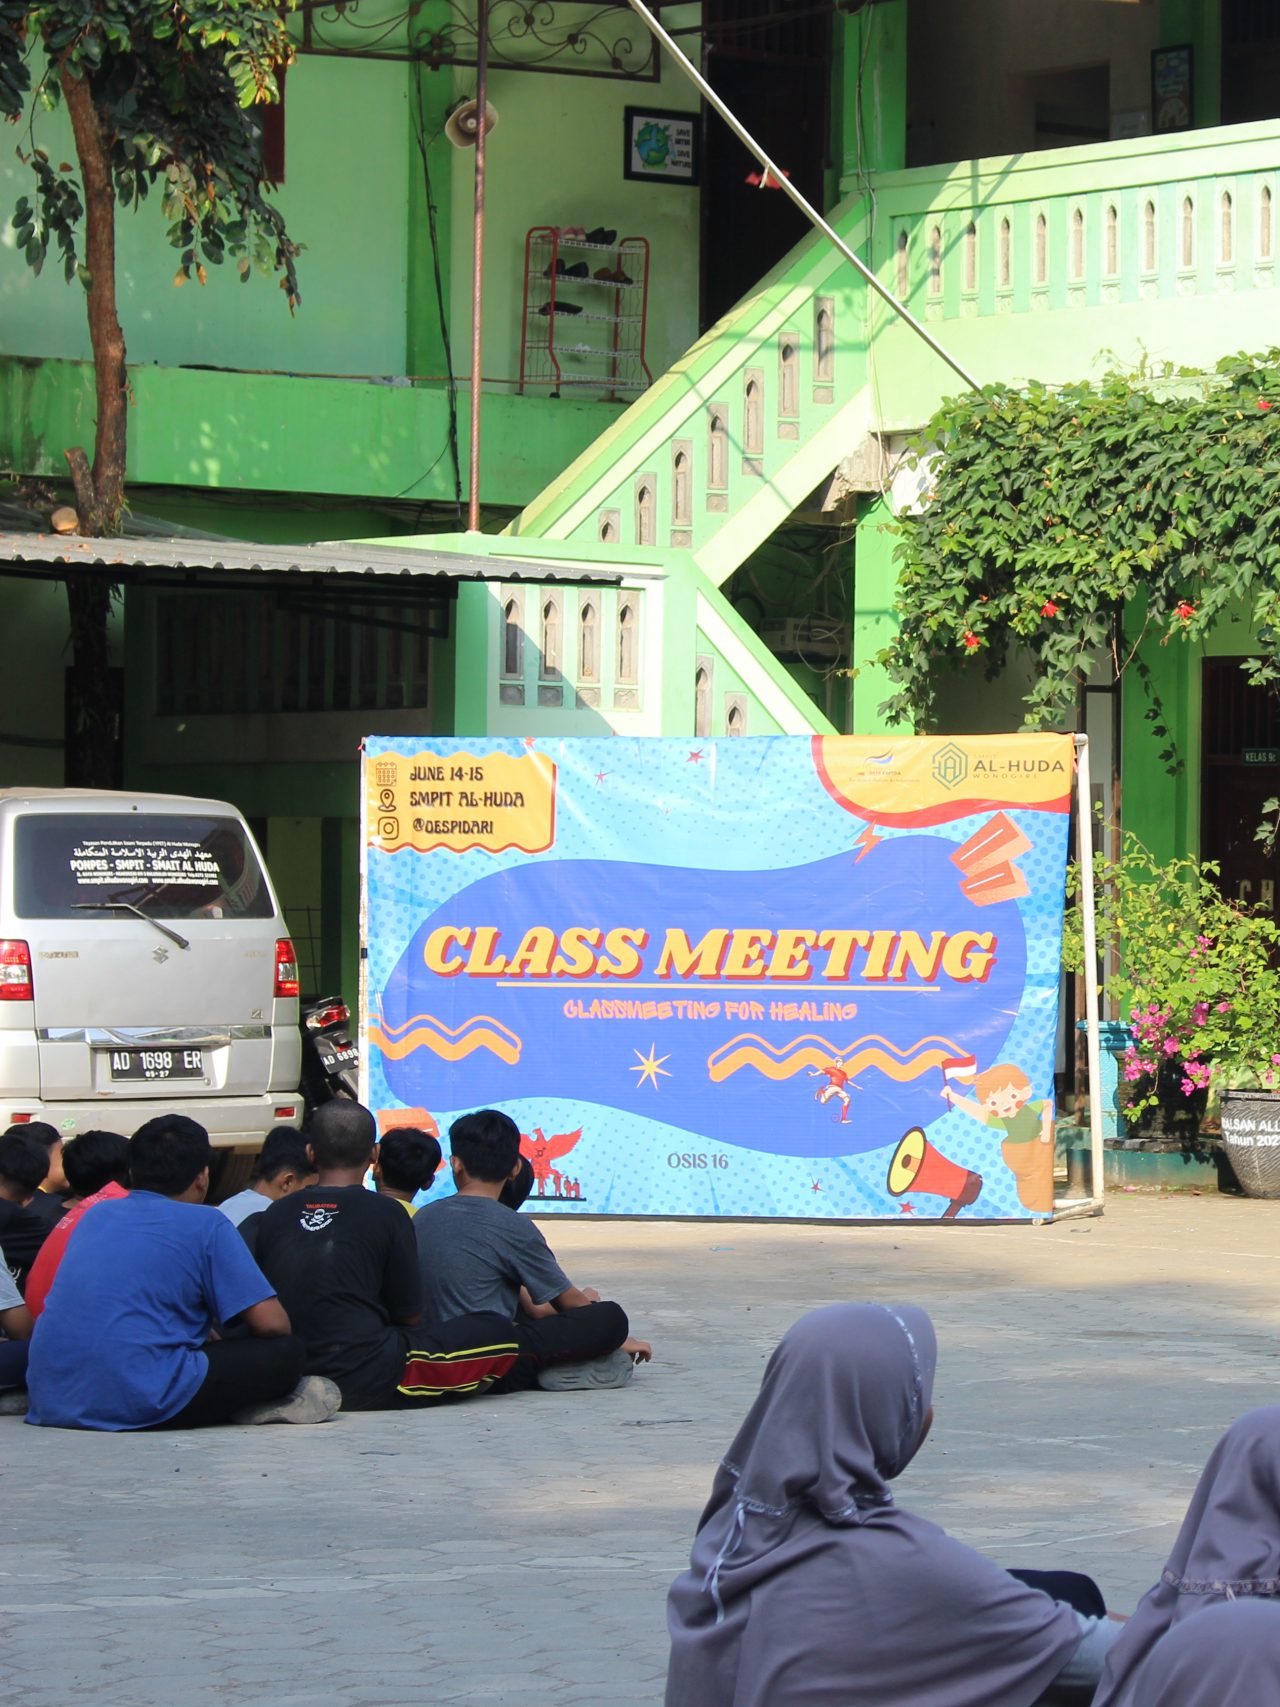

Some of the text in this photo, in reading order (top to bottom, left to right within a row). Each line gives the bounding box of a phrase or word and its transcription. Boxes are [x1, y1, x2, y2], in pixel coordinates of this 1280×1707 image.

[1245, 752, 1265, 762] KELAS
[410, 766, 444, 782] JUNE
[973, 760, 1065, 773] AL-HUDA
[409, 791, 525, 808] SMPIT AL-HUDA
[70, 859, 108, 871] PONPES
[115, 859, 144, 870] SMPIT
[152, 860, 180, 871] SMAIT
[182, 861, 194, 871] AL
[194, 861, 220, 872] HUDA
[424, 926, 997, 983] CLASS MEETING
[725, 1001, 765, 1021] FOR
[769, 1001, 858, 1022] HEALING
[113, 1051, 202, 1071] AD 1698 ER
[323, 1055, 335, 1066] AD
[1224, 1131, 1254, 1146] Tahun
[667, 1153, 729, 1169] OSIS 16
